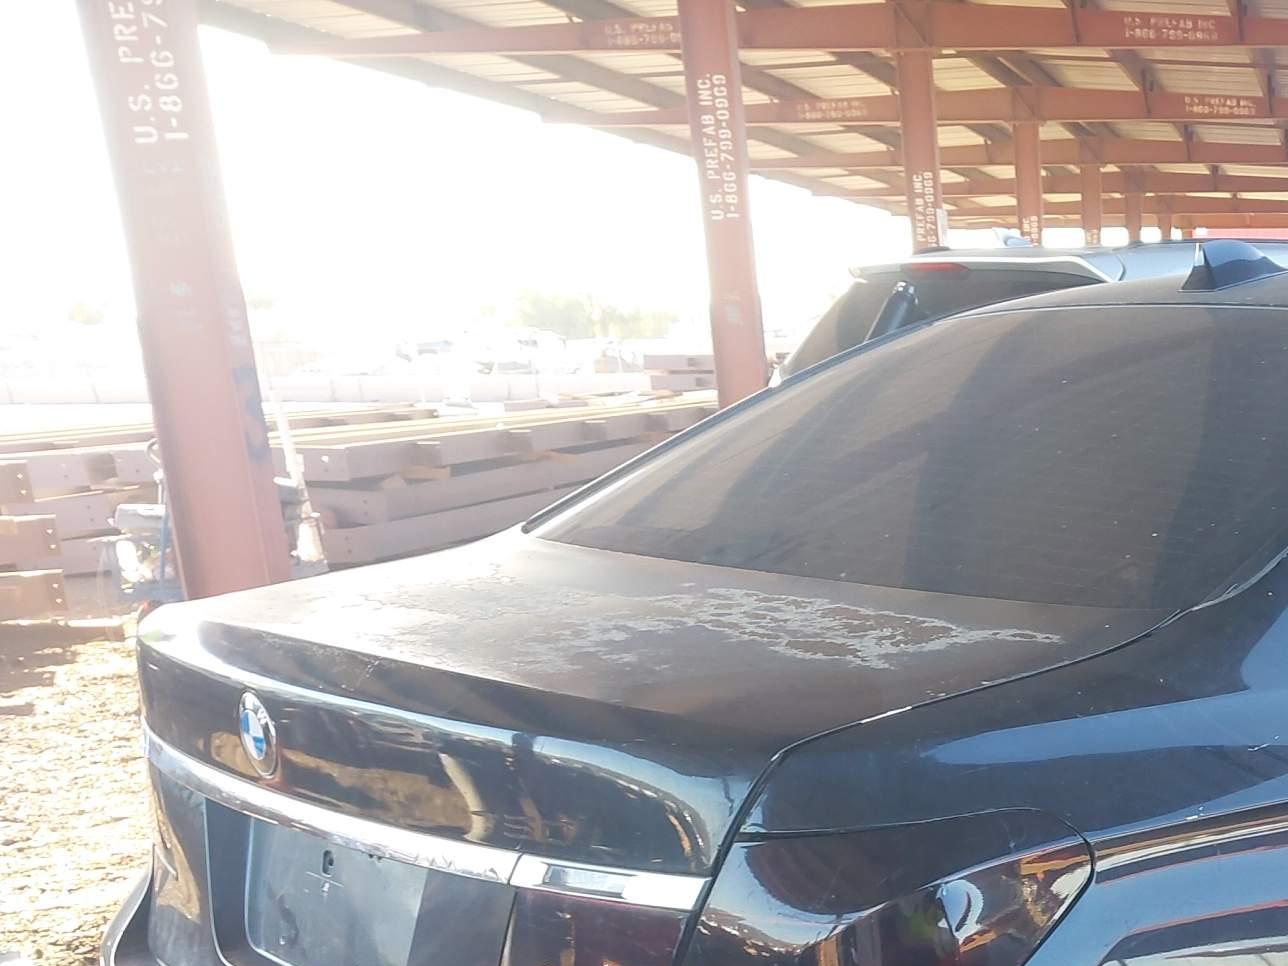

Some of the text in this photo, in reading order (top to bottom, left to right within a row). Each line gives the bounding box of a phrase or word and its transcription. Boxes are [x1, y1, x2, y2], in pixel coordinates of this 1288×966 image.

[127, 84, 159, 143] U.S.
[697, 73, 725, 220] U.S. PREFAB INC.
[712, 74, 740, 218] 1-866-799-0969
